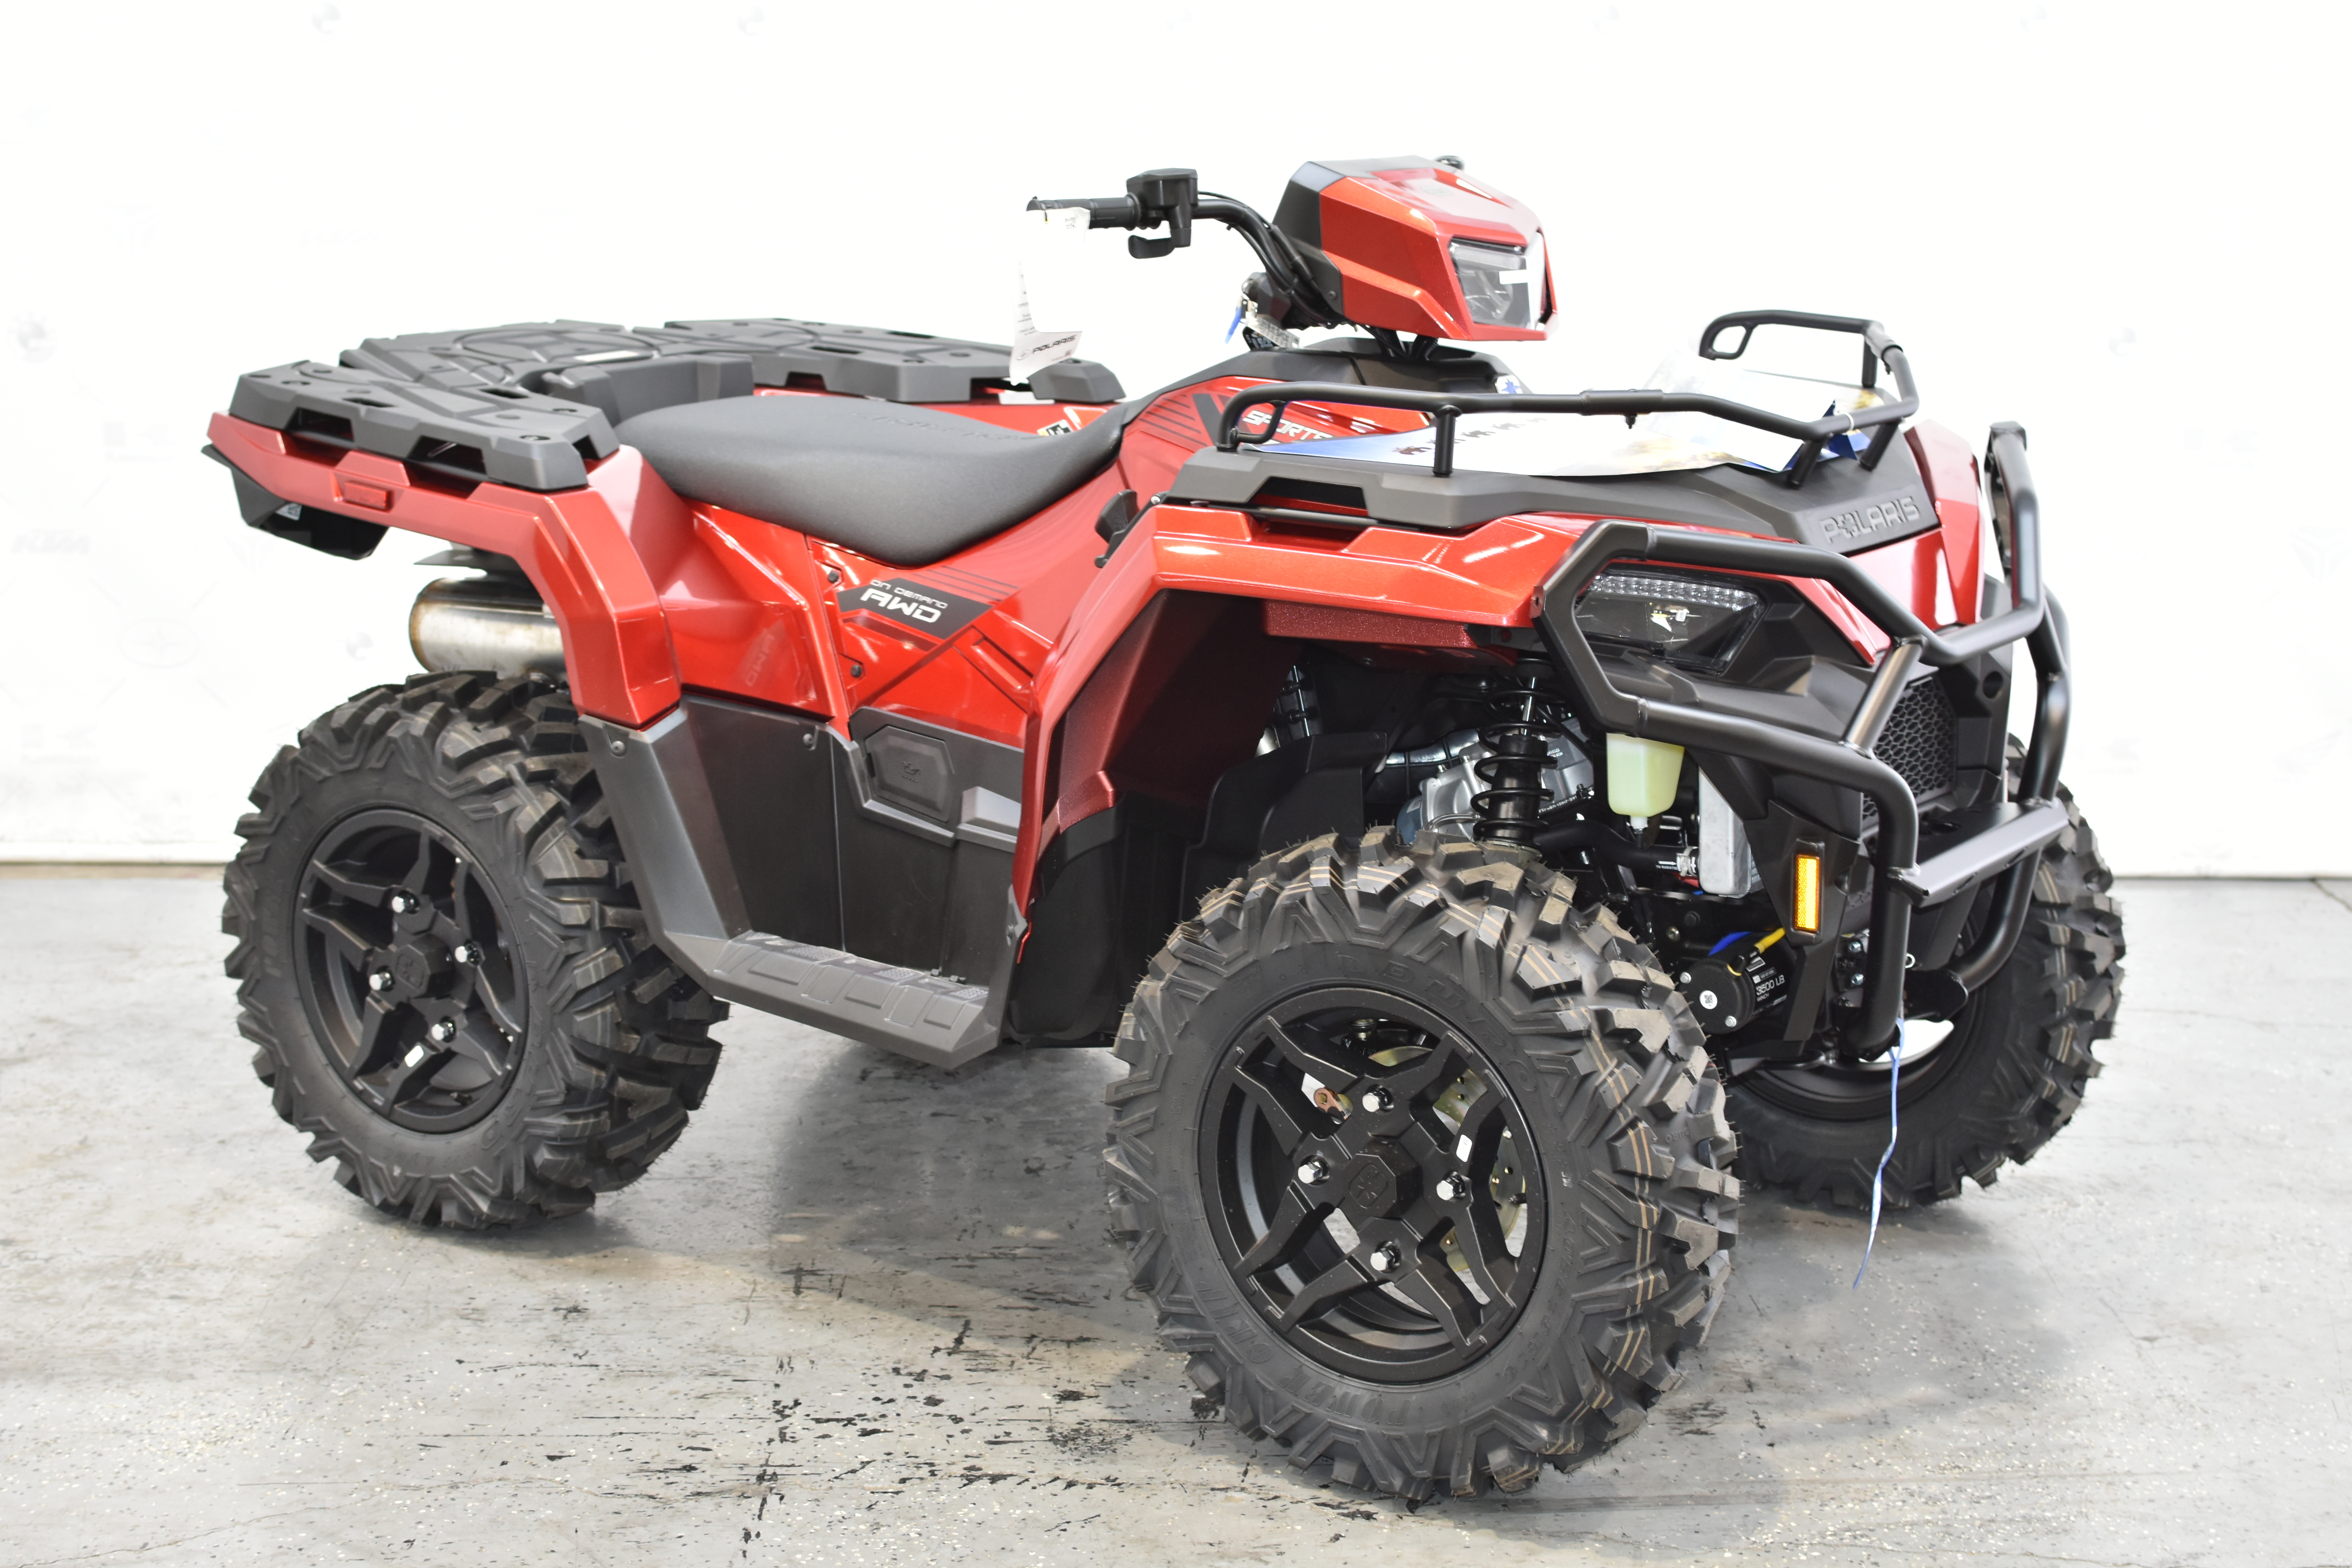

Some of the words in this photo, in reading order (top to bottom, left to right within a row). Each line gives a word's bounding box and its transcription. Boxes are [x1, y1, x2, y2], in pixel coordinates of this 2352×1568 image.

[1032, 335, 1076, 353] POLARIS
[1819, 496, 1920, 544] POLARIS
[860, 588, 942, 623] AWD
[1756, 980, 1775, 996] 3500
[1775, 975, 1786, 986] LB
